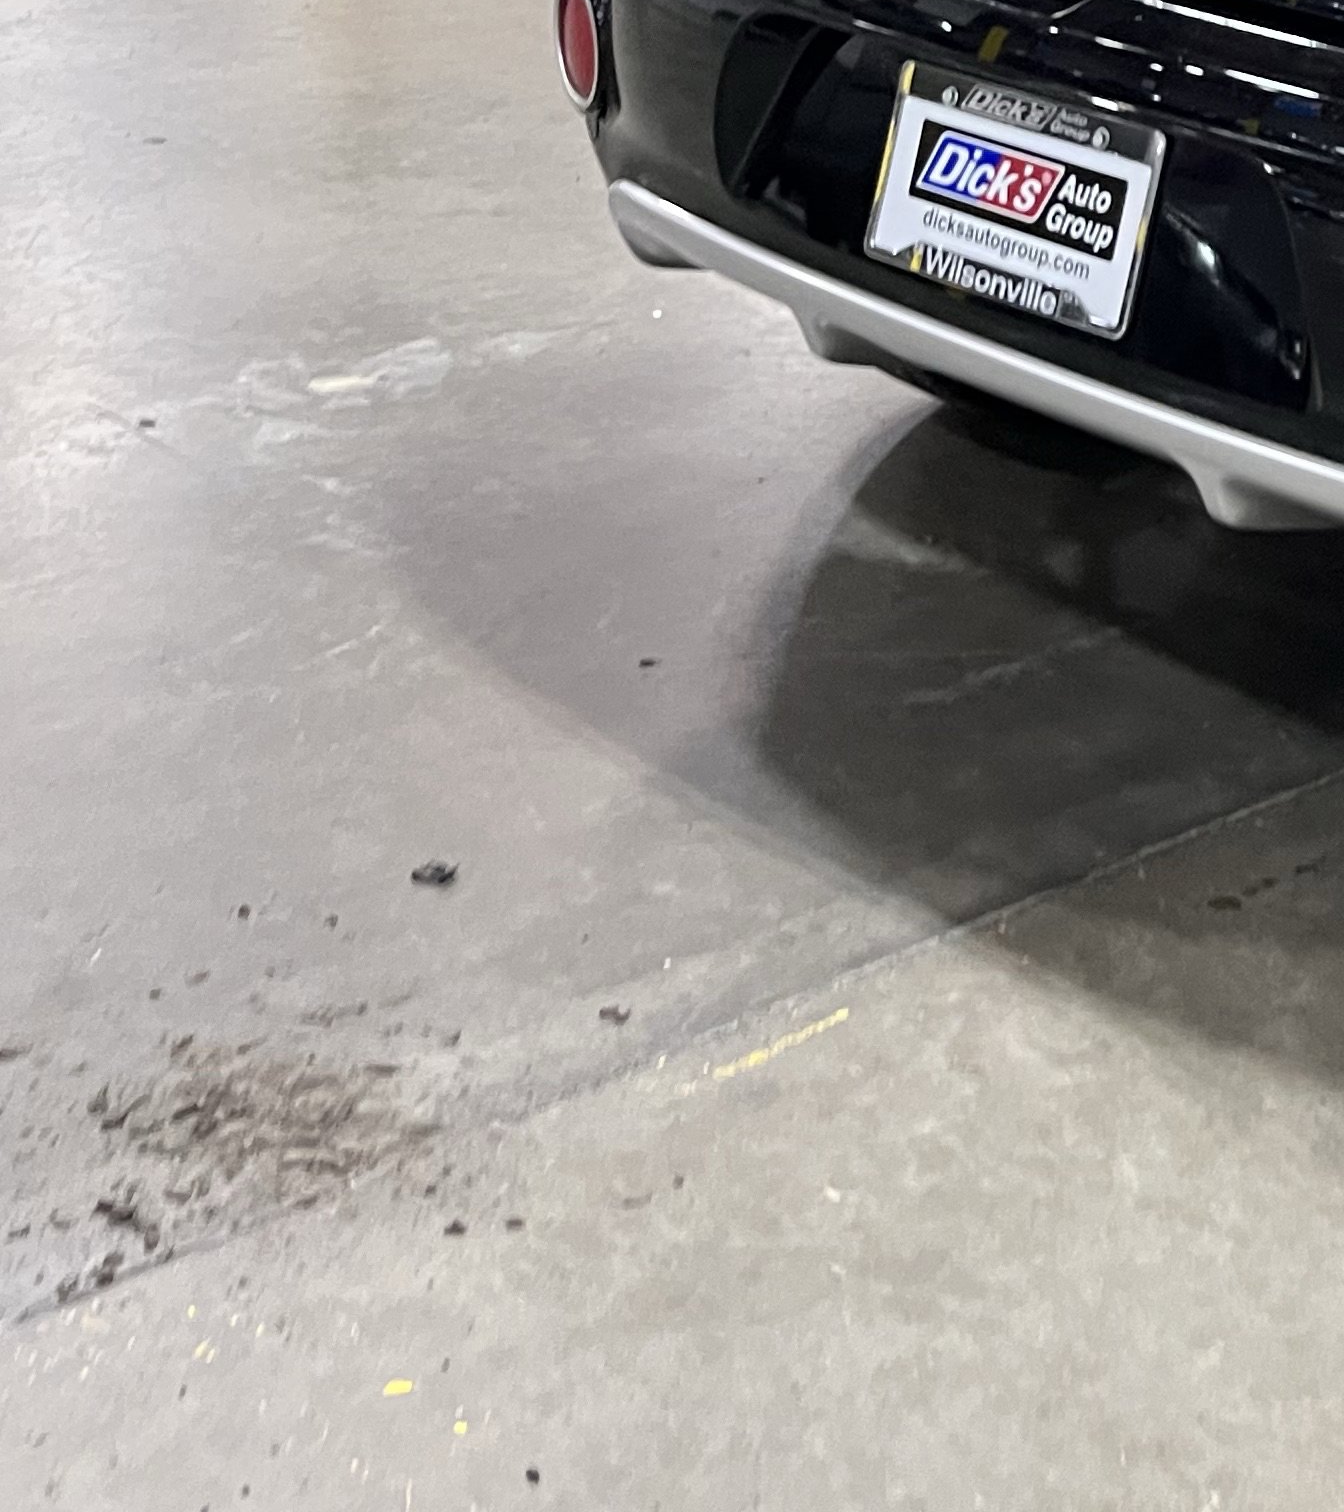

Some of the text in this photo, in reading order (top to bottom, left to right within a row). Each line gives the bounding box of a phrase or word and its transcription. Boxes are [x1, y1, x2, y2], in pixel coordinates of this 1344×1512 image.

[1057, 173, 1112, 214] Auto
[923, 207, 1090, 276] dicksautogroup.com
[1045, 203, 1114, 253] Group
[925, 243, 1057, 316] Wilsonville
